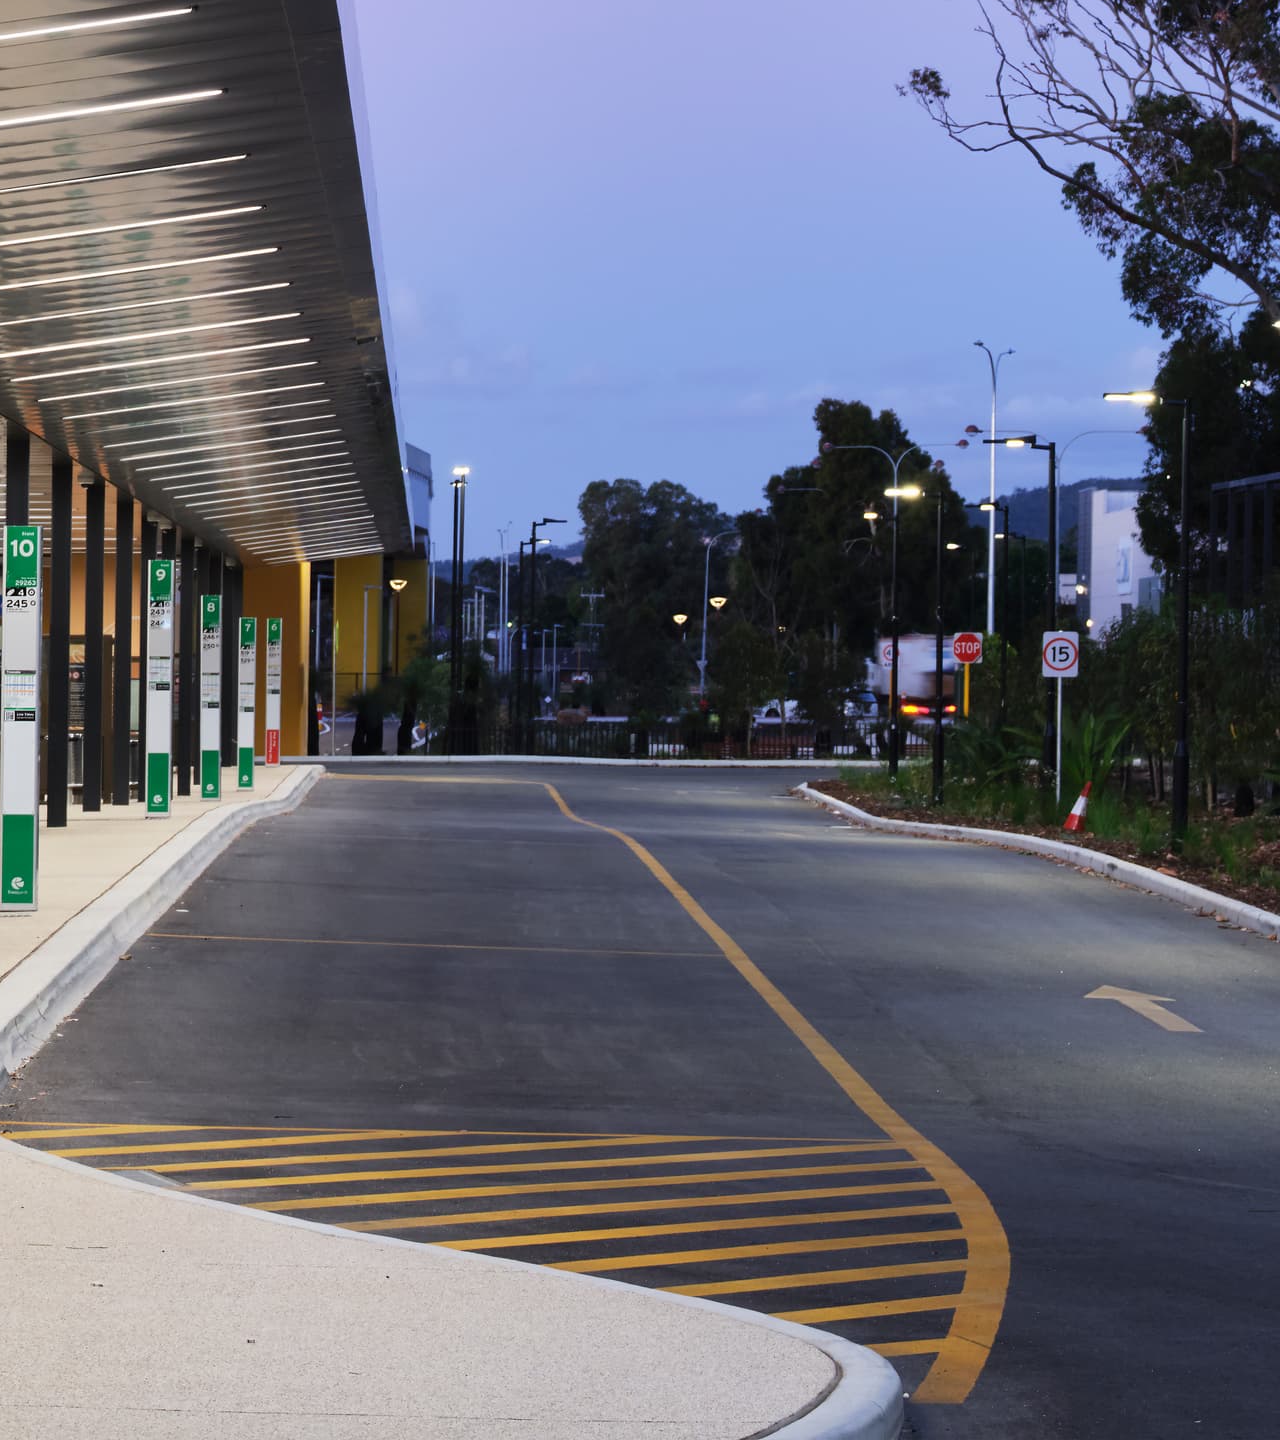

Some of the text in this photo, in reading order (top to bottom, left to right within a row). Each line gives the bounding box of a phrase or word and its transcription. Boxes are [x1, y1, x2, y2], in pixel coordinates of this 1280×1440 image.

[10, 539, 34, 557] 10
[156, 569, 166, 581] 9
[6, 600, 28, 608] 245
[207, 602, 215, 612] 8
[245, 624, 251, 632] 7
[954, 642, 980, 654] STOP
[1051, 646, 1069, 662] 15
